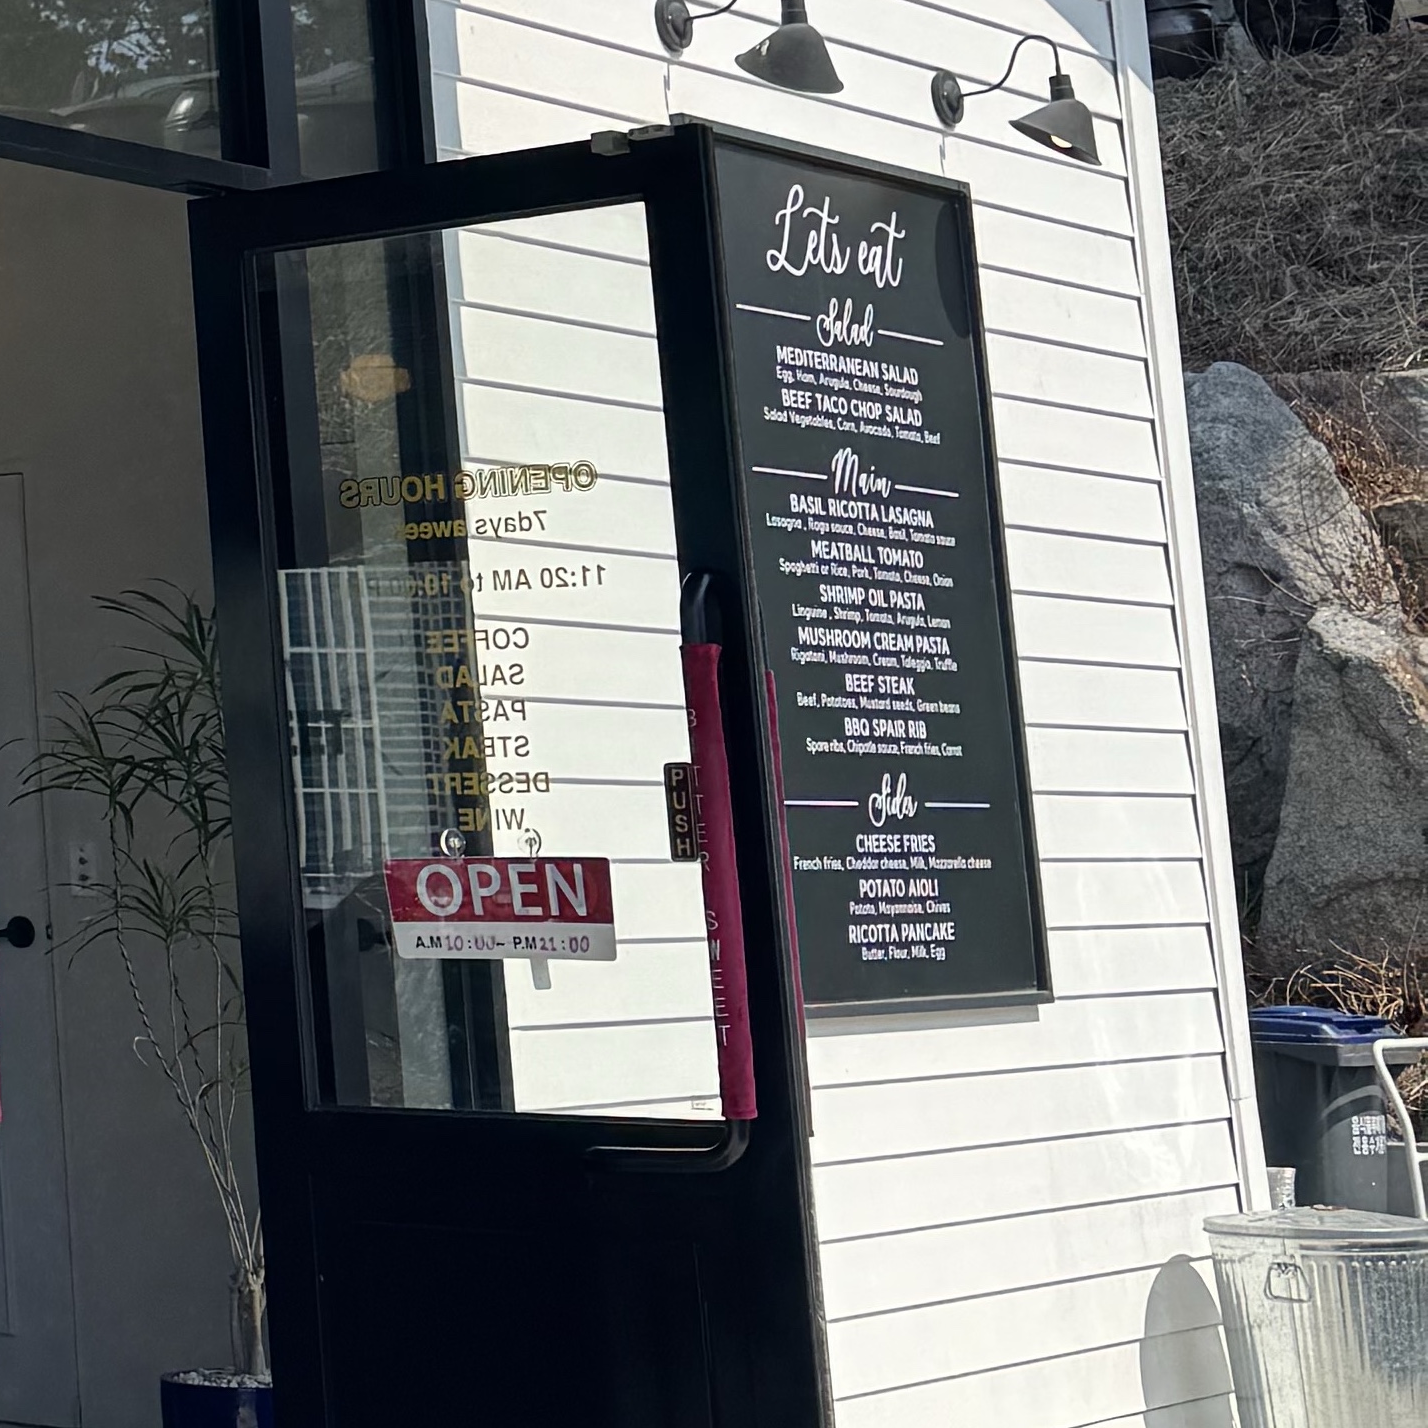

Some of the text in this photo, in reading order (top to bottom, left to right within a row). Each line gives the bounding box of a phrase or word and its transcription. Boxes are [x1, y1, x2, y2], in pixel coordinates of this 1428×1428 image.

[766, 184, 905, 288] Lets eat
[816, 298, 873, 347] Salad
[776, 346, 918, 385] MEDITERRANEAN SALAD
[781, 388, 922, 426] BEEF TACO CHOP SALAD
[831, 447, 891, 498] Main
[790, 494, 934, 528] BASIL RICOTTA LASAGNA
[811, 540, 924, 568] MEATBALL TOMATO
[820, 584, 925, 611] SHRIMP OIL PASTA
[798, 626, 950, 655] MUSHROOM CREAM PASTA
[846, 674, 915, 695] BEEF STEAK
[844, 717, 927, 739] BBQ SPAIR RIB
[670, 768, 692, 857] PUSH
[868, 772, 918, 827] Sides
[856, 834, 935, 853] CHEESE FRIES
[416, 863, 587, 917] OPEN
[859, 878, 938, 898] POTATO AIOLI
[849, 923, 955, 944] RICOTTA PANCAKE
